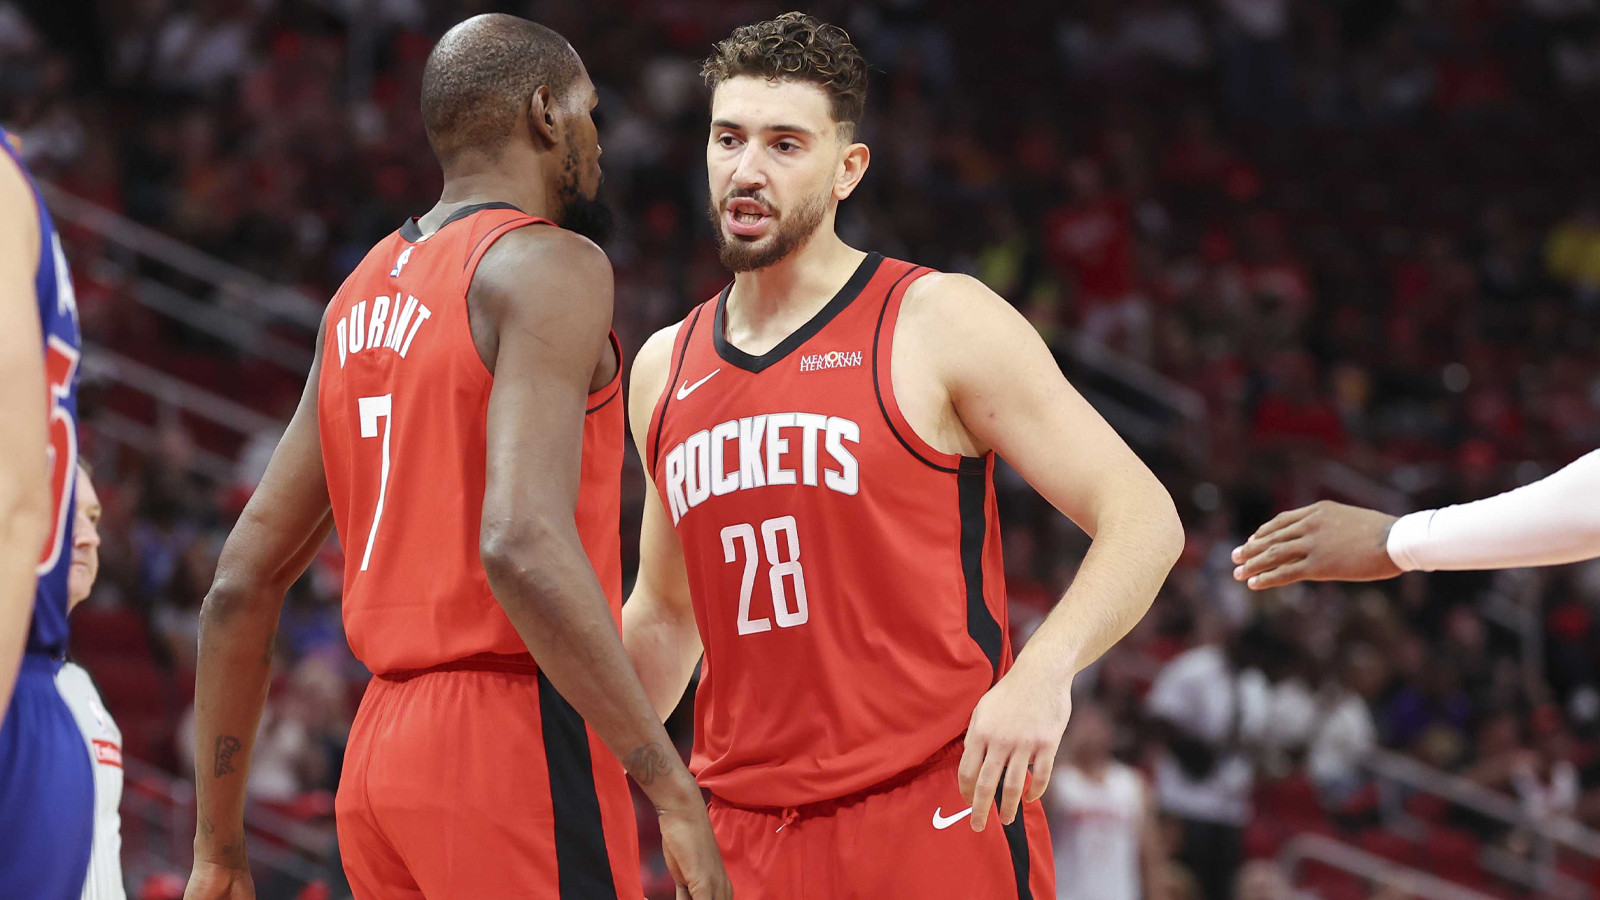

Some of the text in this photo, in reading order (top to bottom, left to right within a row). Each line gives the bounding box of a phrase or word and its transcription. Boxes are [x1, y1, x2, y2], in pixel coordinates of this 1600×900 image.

[800, 357, 861, 371] HERMANN
[801, 351, 862, 364] MEMORIAL
[358, 393, 392, 571] 7
[665, 412, 860, 528] ROCKETS
[720, 515, 809, 636] 28
